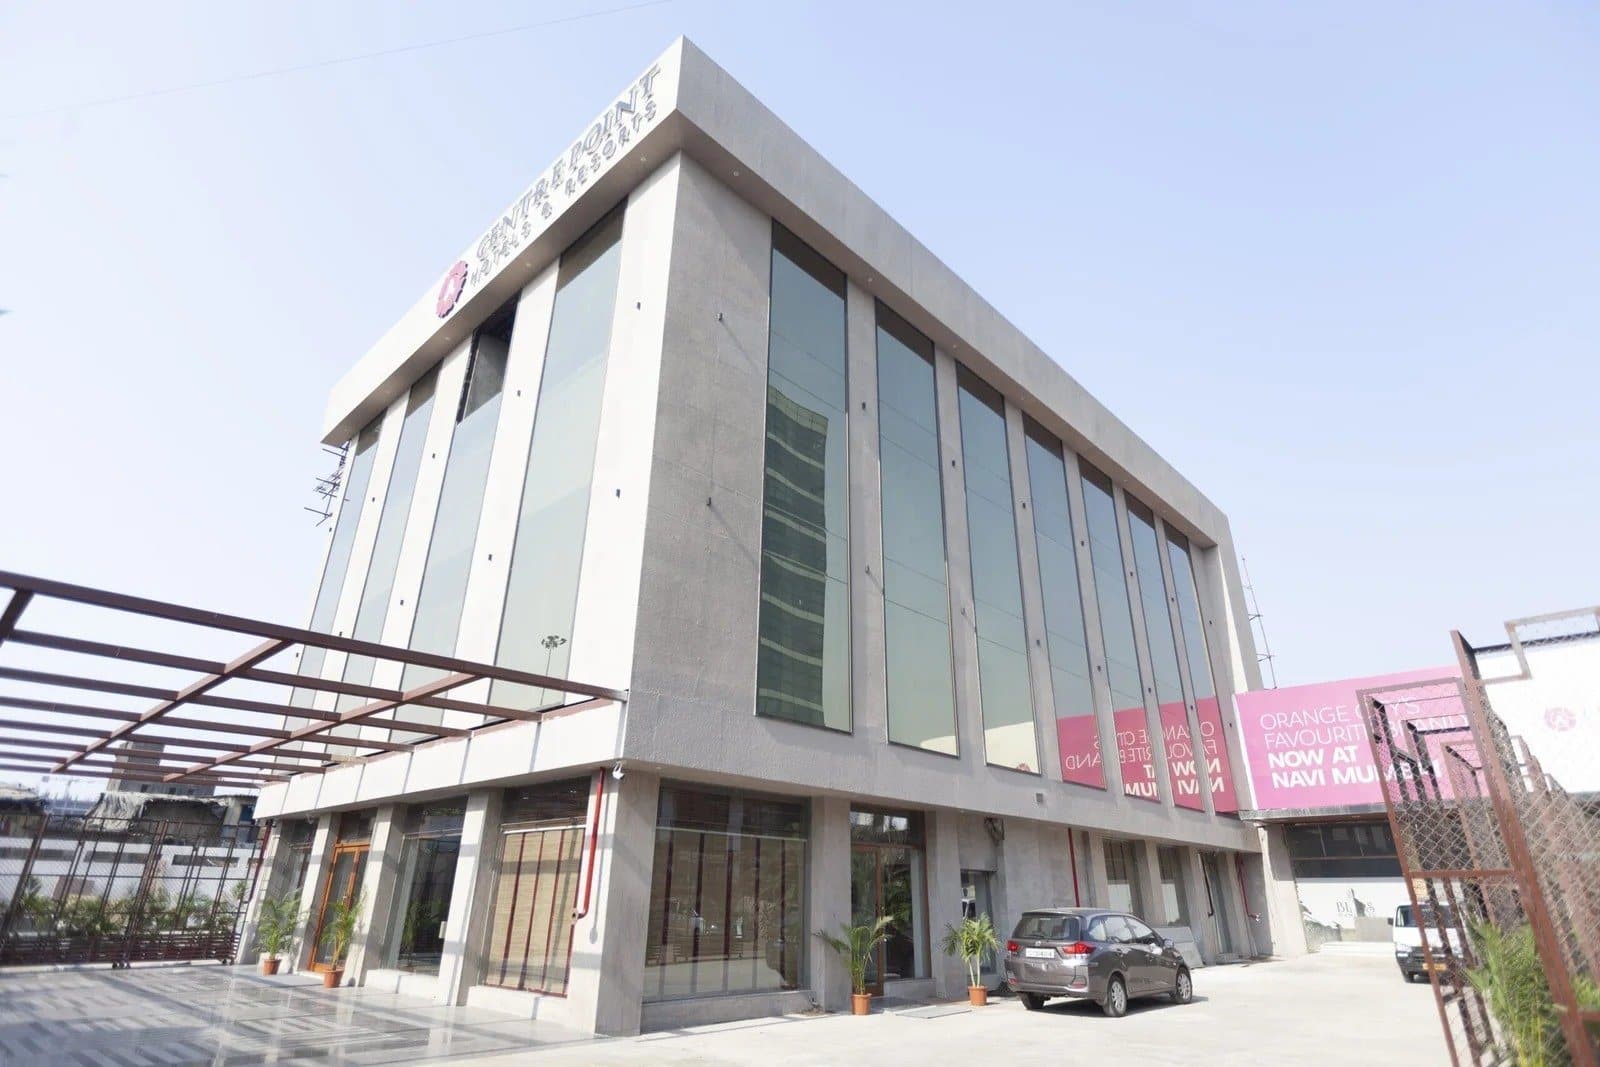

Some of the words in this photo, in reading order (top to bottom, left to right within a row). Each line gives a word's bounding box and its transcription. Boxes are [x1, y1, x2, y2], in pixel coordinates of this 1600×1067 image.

[476, 158, 566, 261] CENTRE
[568, 64, 661, 174] POINT
[470, 221, 531, 288] HOTELS
[565, 100, 657, 198] RESORTS
[1260, 704, 1351, 731] ORANGE
[1267, 748, 1324, 769] NOW
[1332, 745, 1358, 765] AT
[1271, 768, 1326, 788] NAVI
